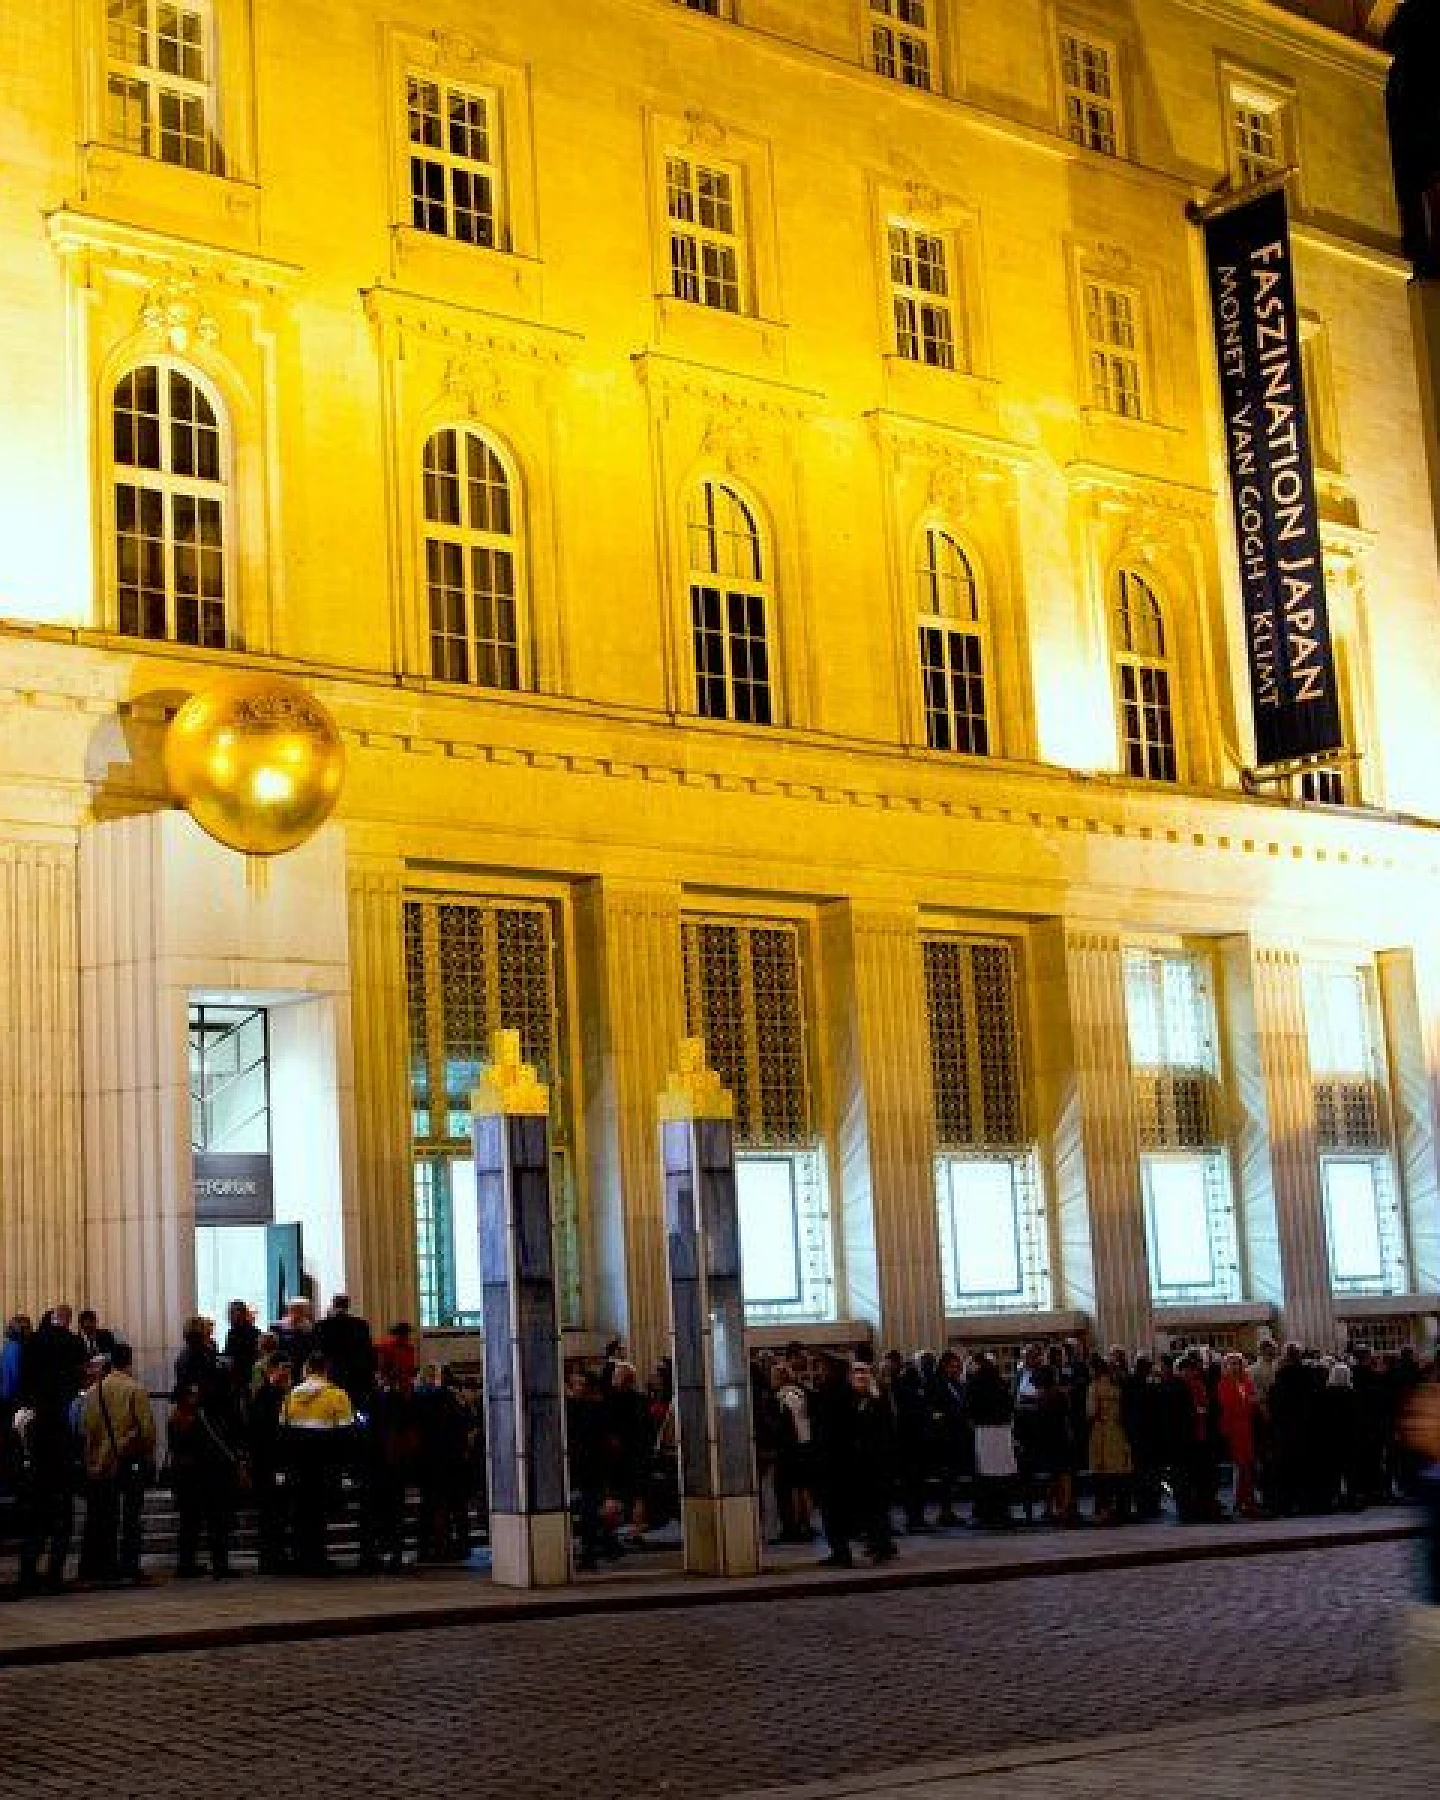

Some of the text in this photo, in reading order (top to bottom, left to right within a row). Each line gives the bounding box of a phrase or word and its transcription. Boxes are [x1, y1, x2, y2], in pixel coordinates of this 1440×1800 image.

[1217, 266, 1280, 706] MONET VAN GOGH KLIMT
[1250, 240, 1324, 700] FASZINATION JAPAN
